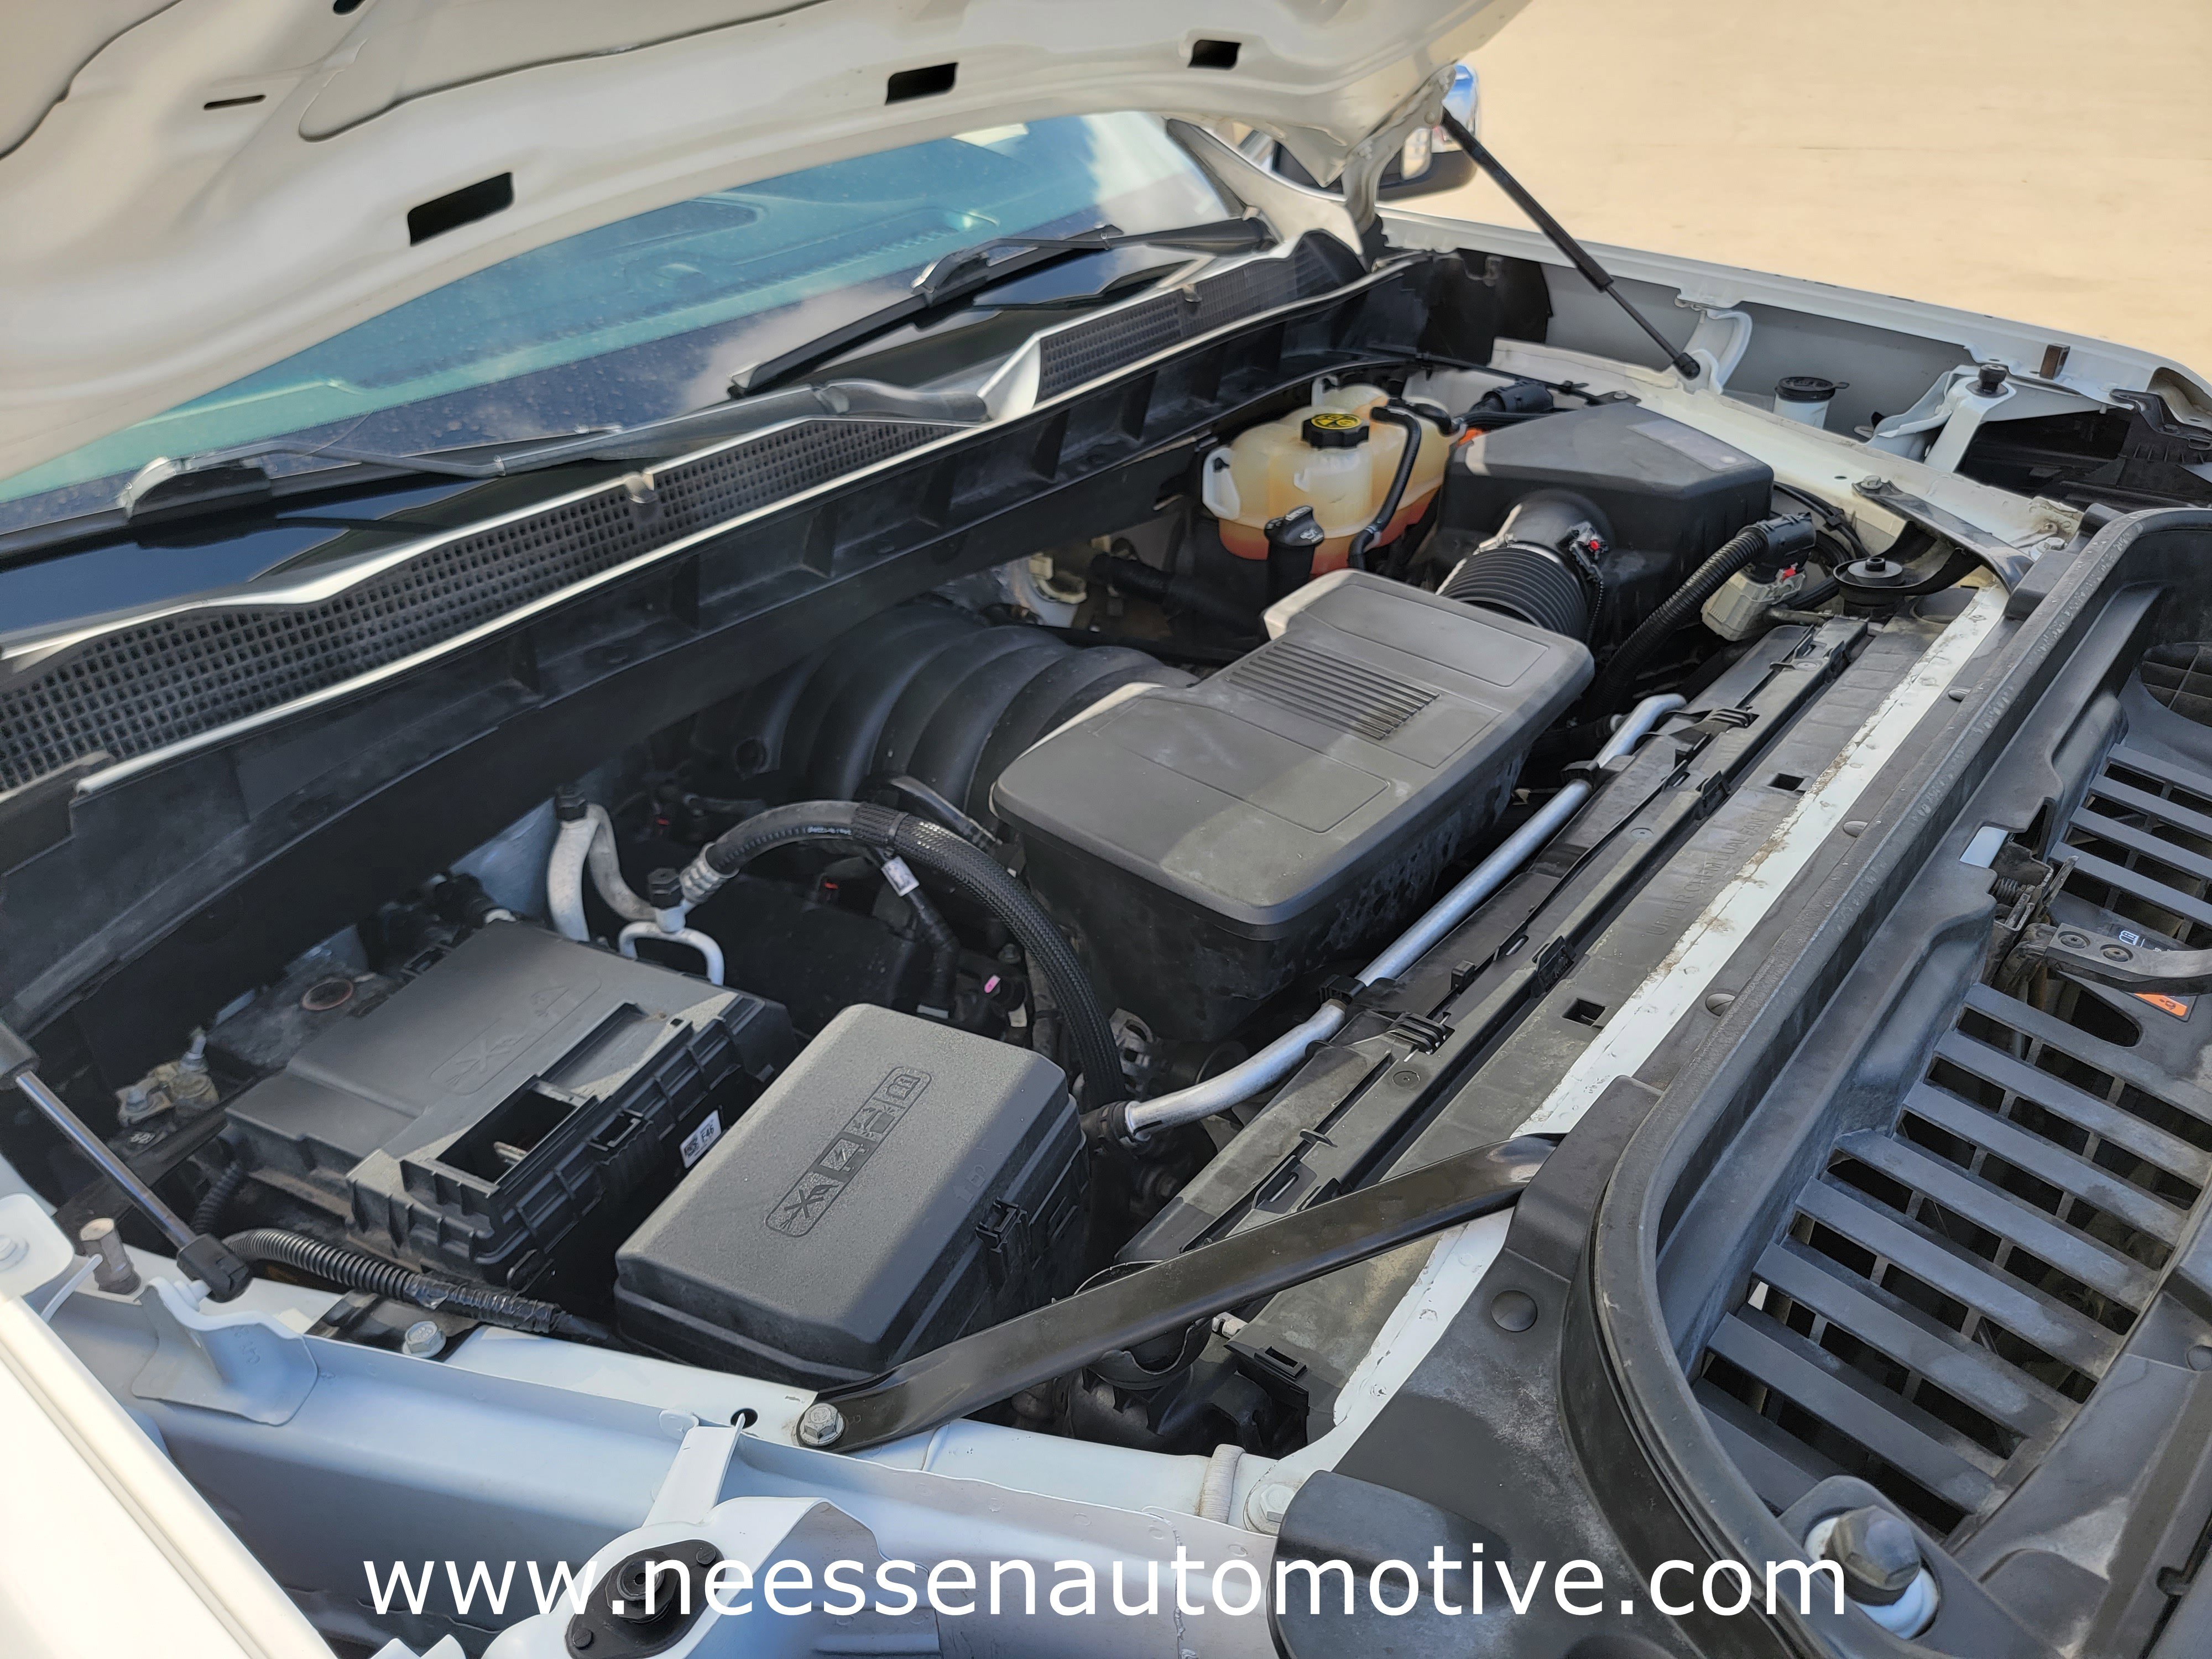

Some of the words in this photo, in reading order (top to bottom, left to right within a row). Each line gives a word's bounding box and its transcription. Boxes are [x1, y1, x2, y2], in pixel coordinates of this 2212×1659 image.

[1646, 894, 1695, 936] UPPER
[1712, 837, 1751, 861] DUAL
[1741, 817, 1768, 836] FAN
